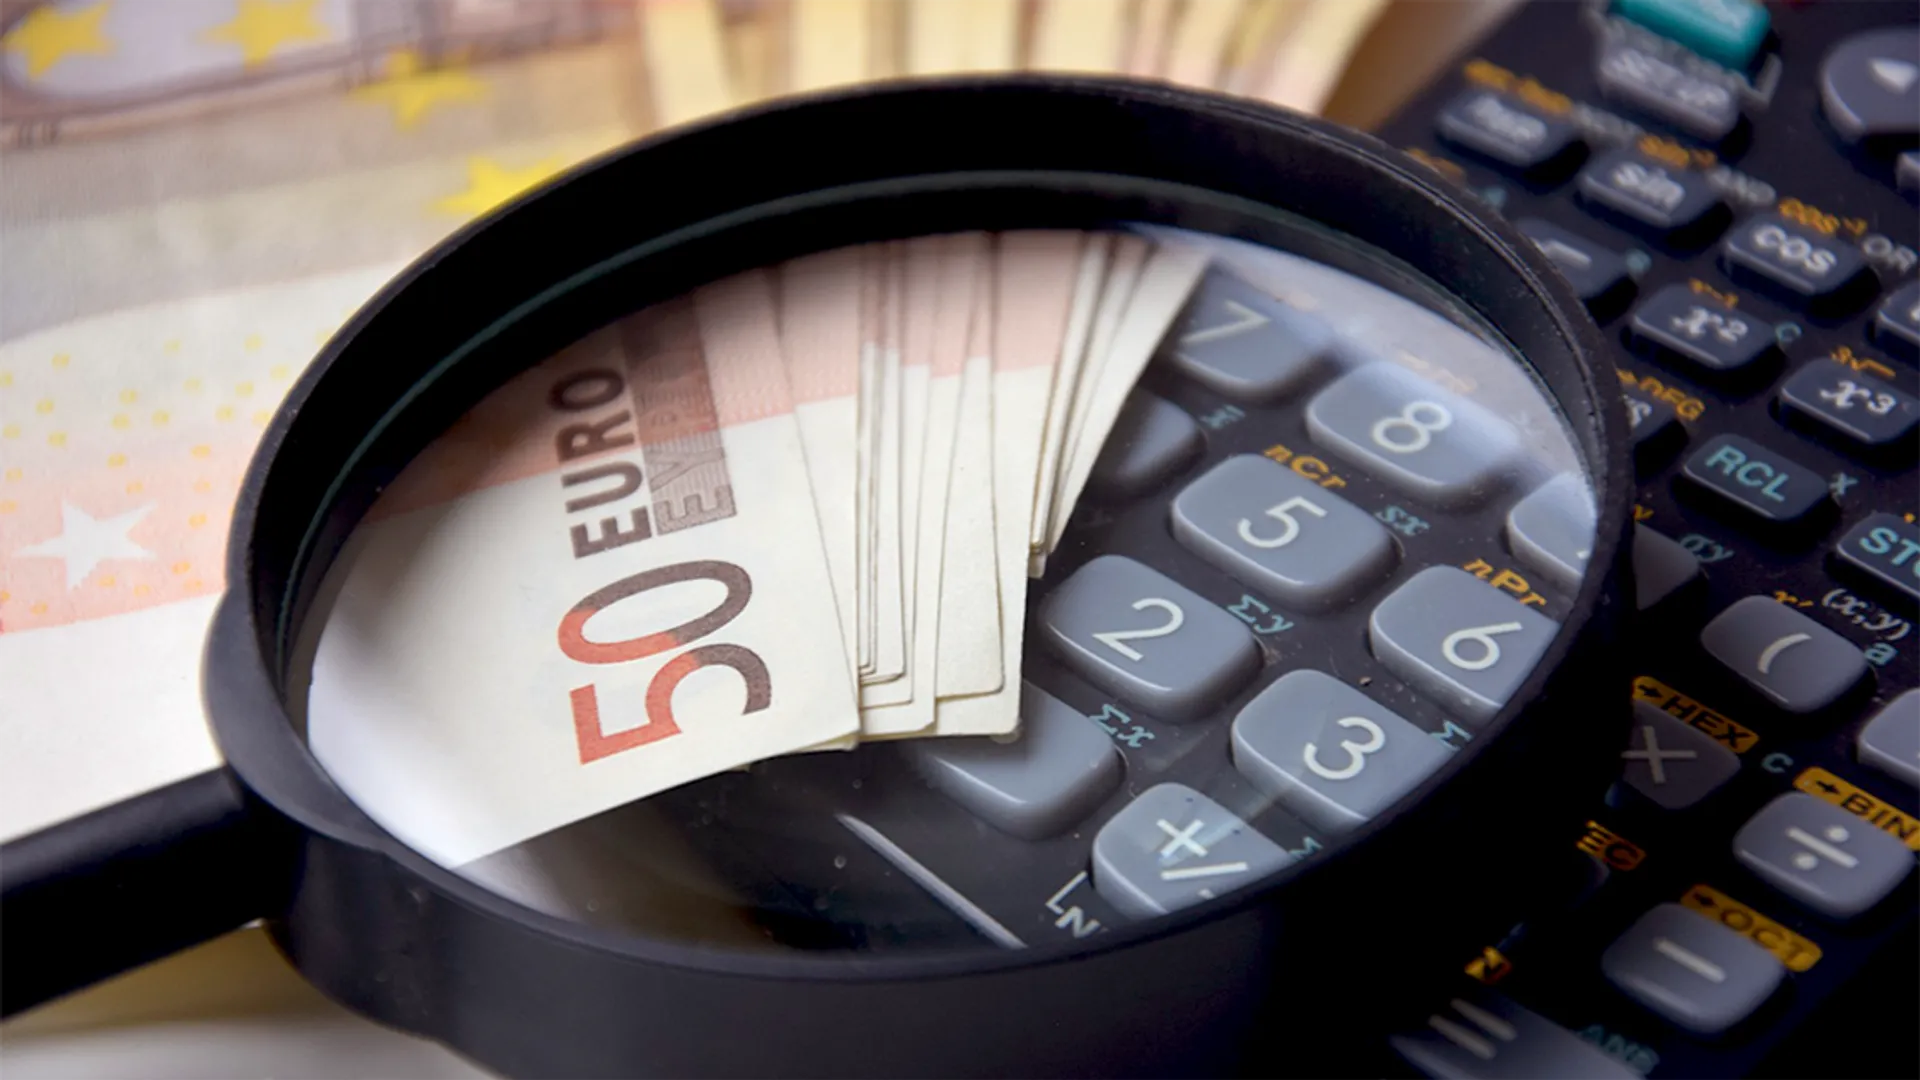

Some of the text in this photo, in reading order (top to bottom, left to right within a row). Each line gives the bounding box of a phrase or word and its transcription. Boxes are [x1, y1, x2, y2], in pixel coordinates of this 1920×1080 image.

[1755, 225, 1837, 275] cos
[1372, 400, 1453, 454] 8
[548, 366, 653, 559] EURO
[1264, 444, 1347, 491] nCr
[1705, 444, 1789, 502] RCL
[1238, 496, 1329, 549] 5
[1859, 526, 1920, 578] ST
[1463, 557, 1548, 609] nPr
[1093, 598, 1185, 662] 2
[1442, 621, 1523, 671] 6
[557, 559, 772, 766] 50
[1304, 716, 1386, 780] 3
[1659, 695, 1753, 750] HEX
[1840, 793, 1920, 841] BIN
